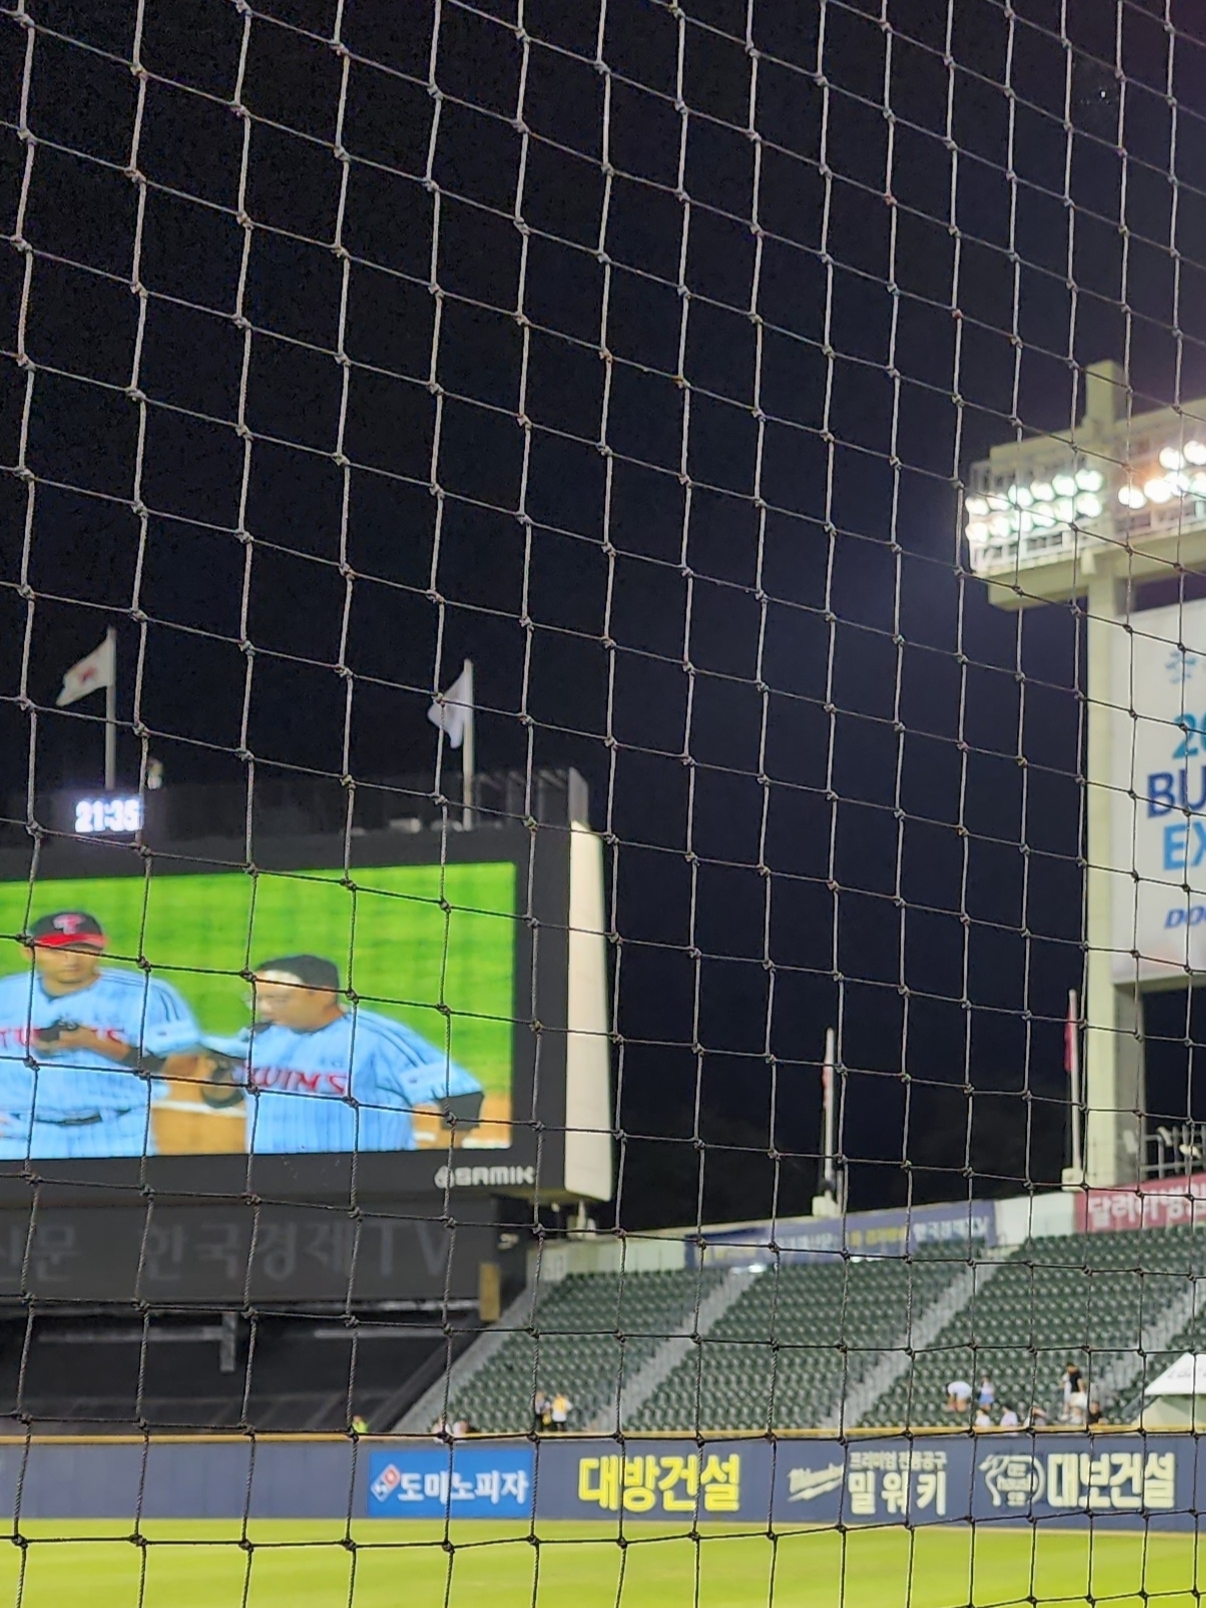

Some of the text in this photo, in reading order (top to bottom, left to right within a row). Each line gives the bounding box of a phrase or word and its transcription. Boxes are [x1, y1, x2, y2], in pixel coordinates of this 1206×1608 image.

[138, 1218, 454, 1284] 한국경제TV
[397, 1469, 529, 1505] 도미노피자
[577, 1453, 741, 1512] 대방건설
[848, 1470, 947, 1516] 밀워키
[1047, 1452, 1175, 1509] 대보건설
